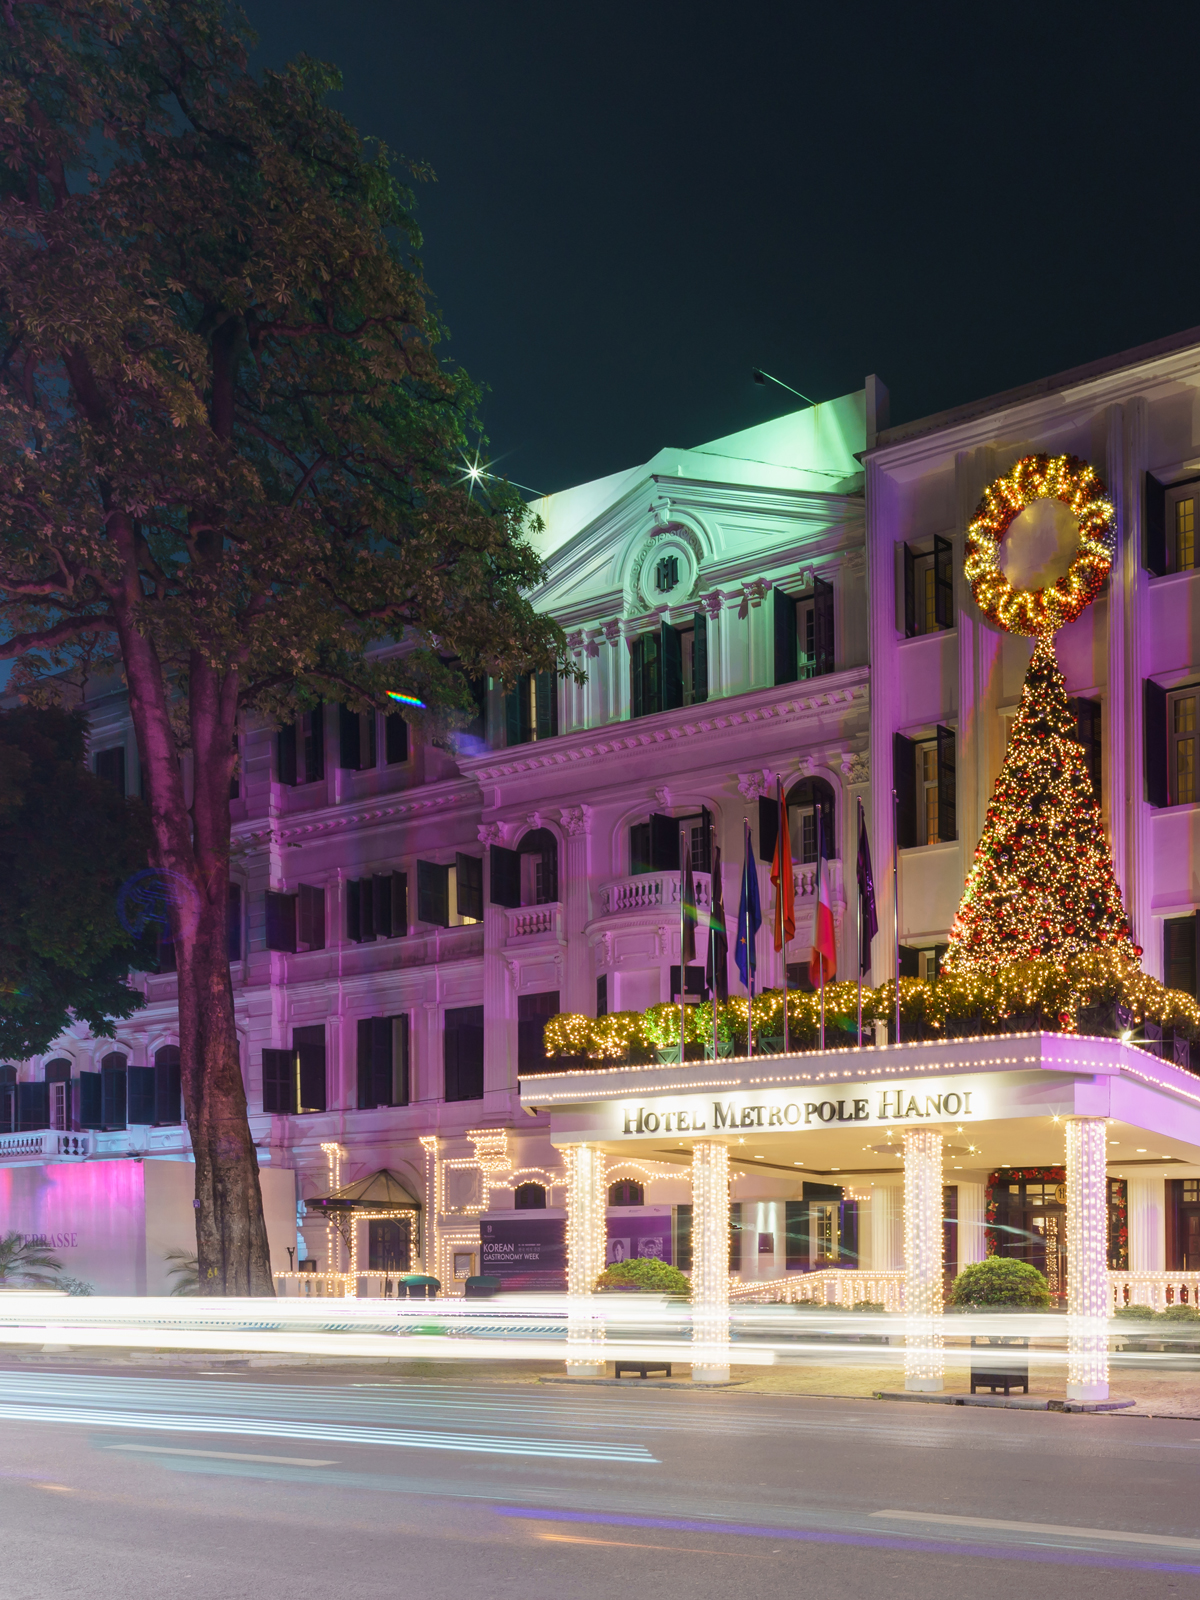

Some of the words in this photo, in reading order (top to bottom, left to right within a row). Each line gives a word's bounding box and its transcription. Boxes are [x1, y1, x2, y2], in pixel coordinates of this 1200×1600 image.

[622, 1107, 706, 1135] HOTEL
[712, 1099, 869, 1130] METROPOLE
[875, 1089, 972, 1119] HANOI
[483, 1243, 515, 1253] KOREAN
[483, 1252, 523, 1261] GASTRONOMY
[524, 1252, 540, 1260] WEEK
